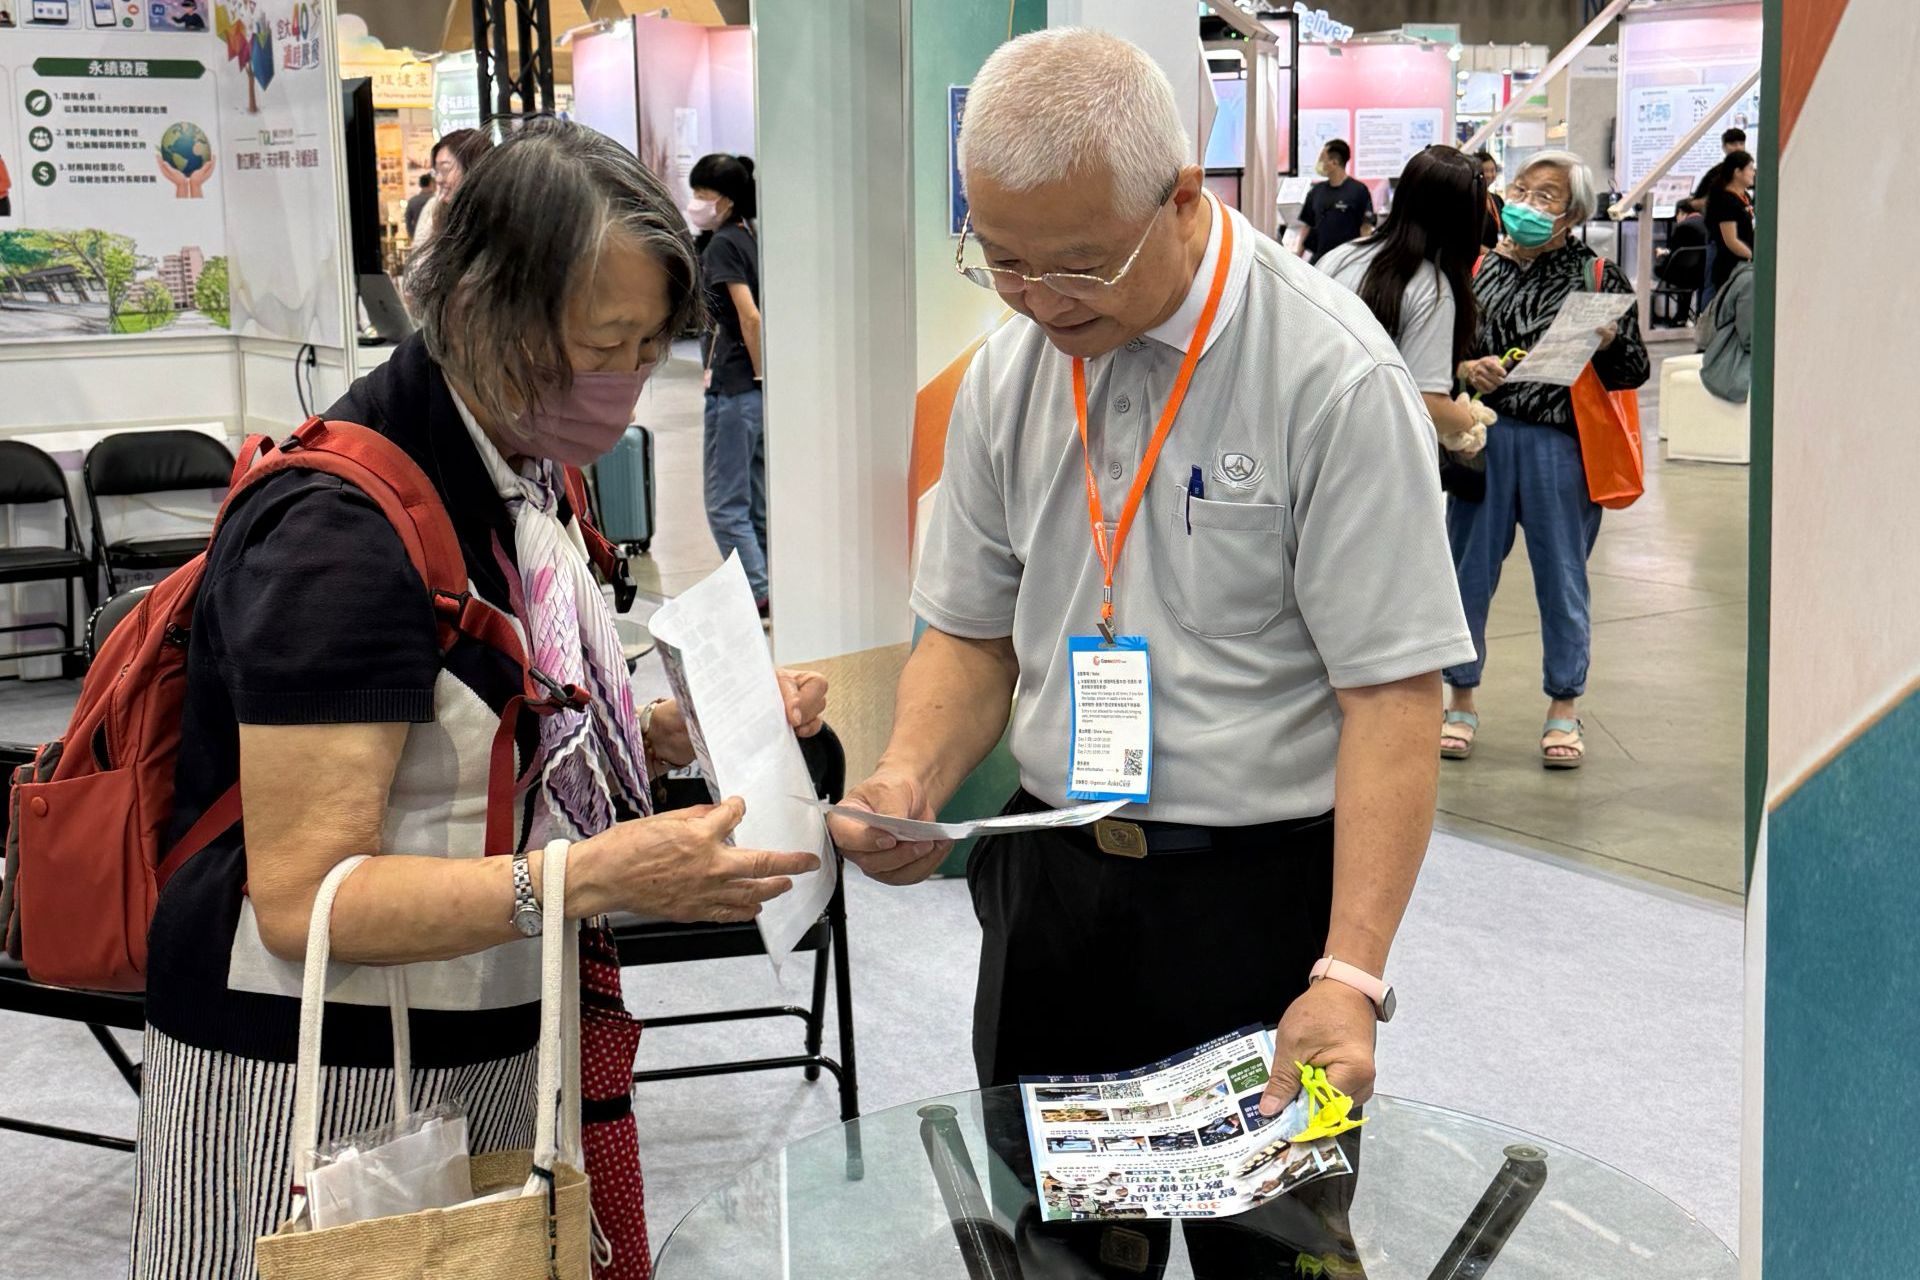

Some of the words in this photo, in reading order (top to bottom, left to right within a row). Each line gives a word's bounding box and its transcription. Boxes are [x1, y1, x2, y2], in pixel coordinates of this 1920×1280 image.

[88, 60, 149, 76] 永續發展
[1136, 1179, 1224, 1193] 數位轉型
[1129, 1186, 1238, 1203] 智慧生活與
